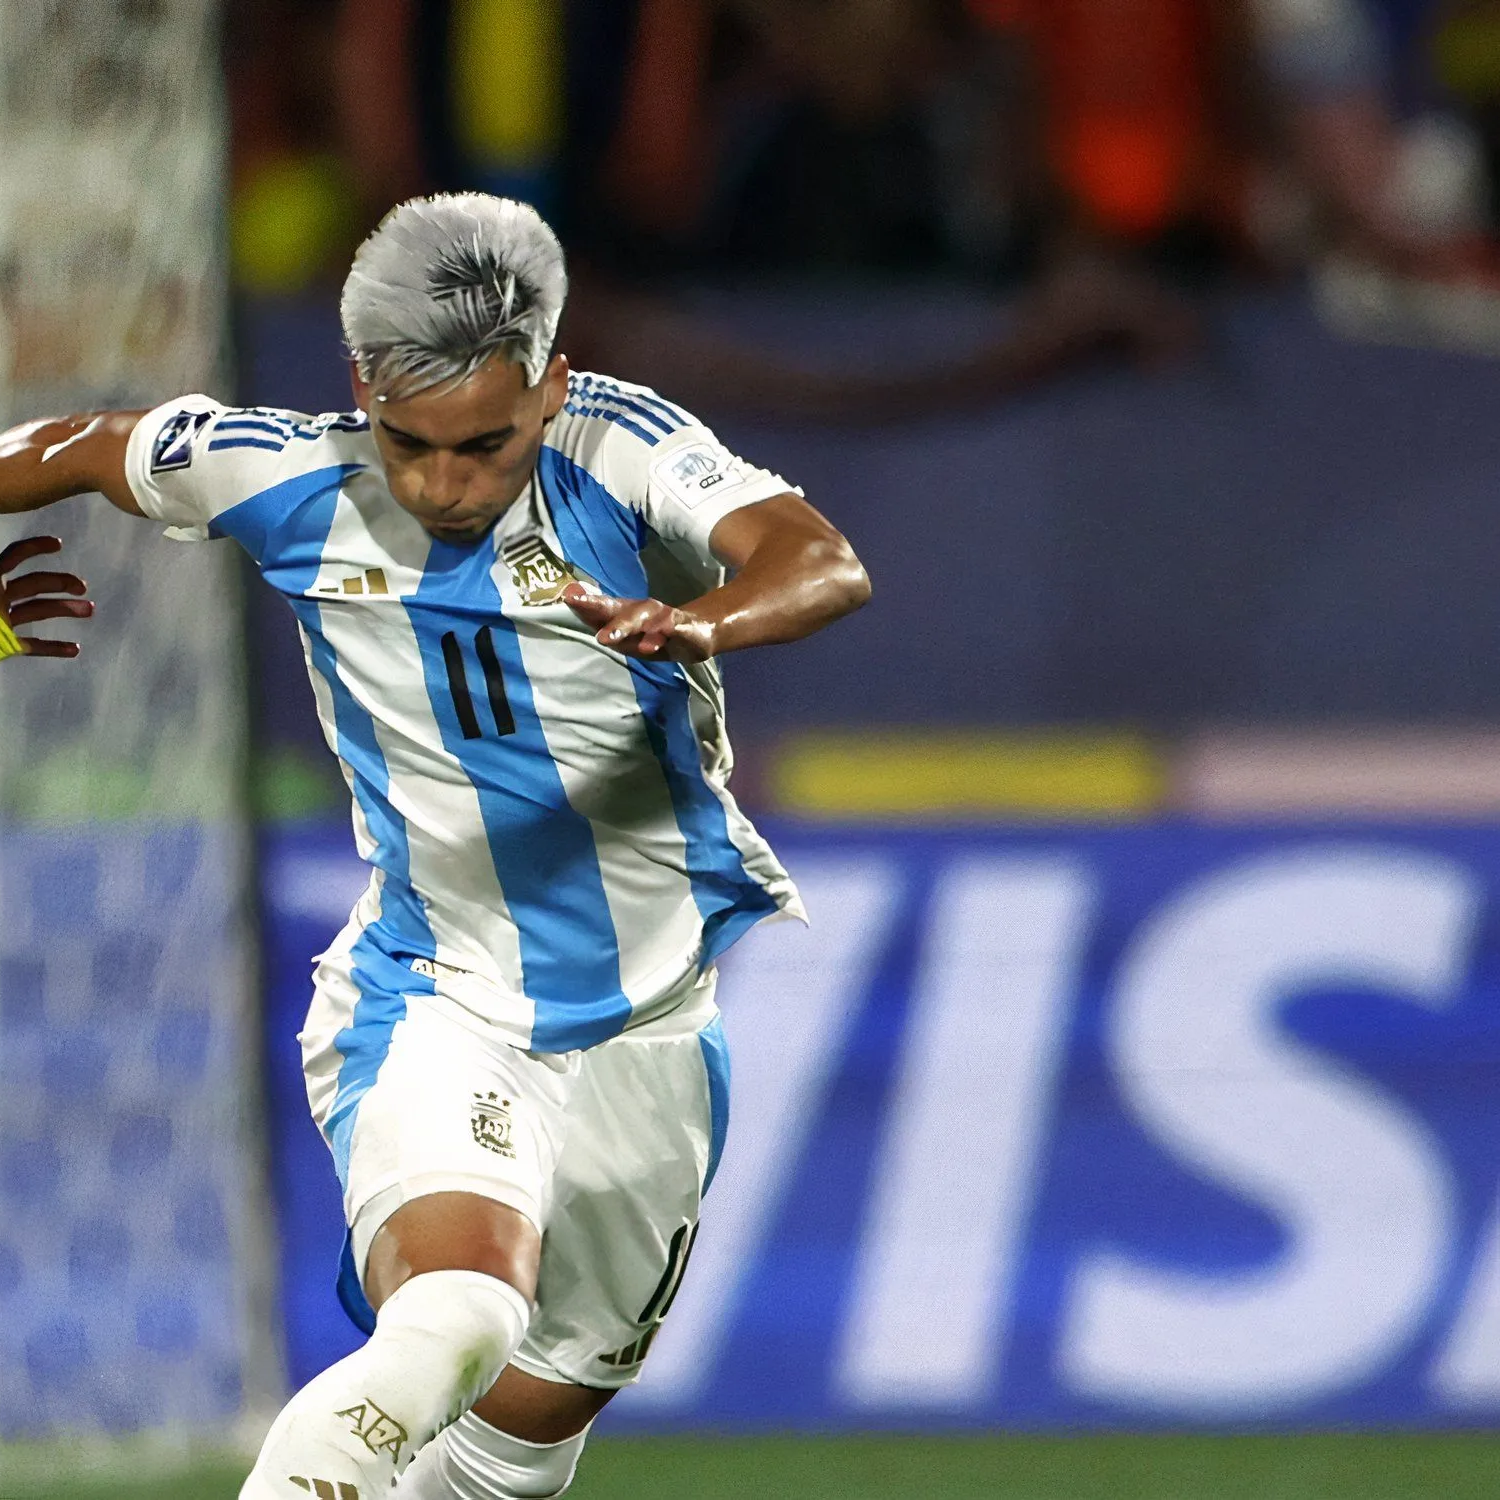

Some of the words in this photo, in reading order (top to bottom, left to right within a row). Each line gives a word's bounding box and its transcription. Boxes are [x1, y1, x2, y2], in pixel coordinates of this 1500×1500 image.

[441, 625, 516, 740] 11
[272, 838, 1500, 1417] VIS
[333, 1397, 408, 1465] AFA
